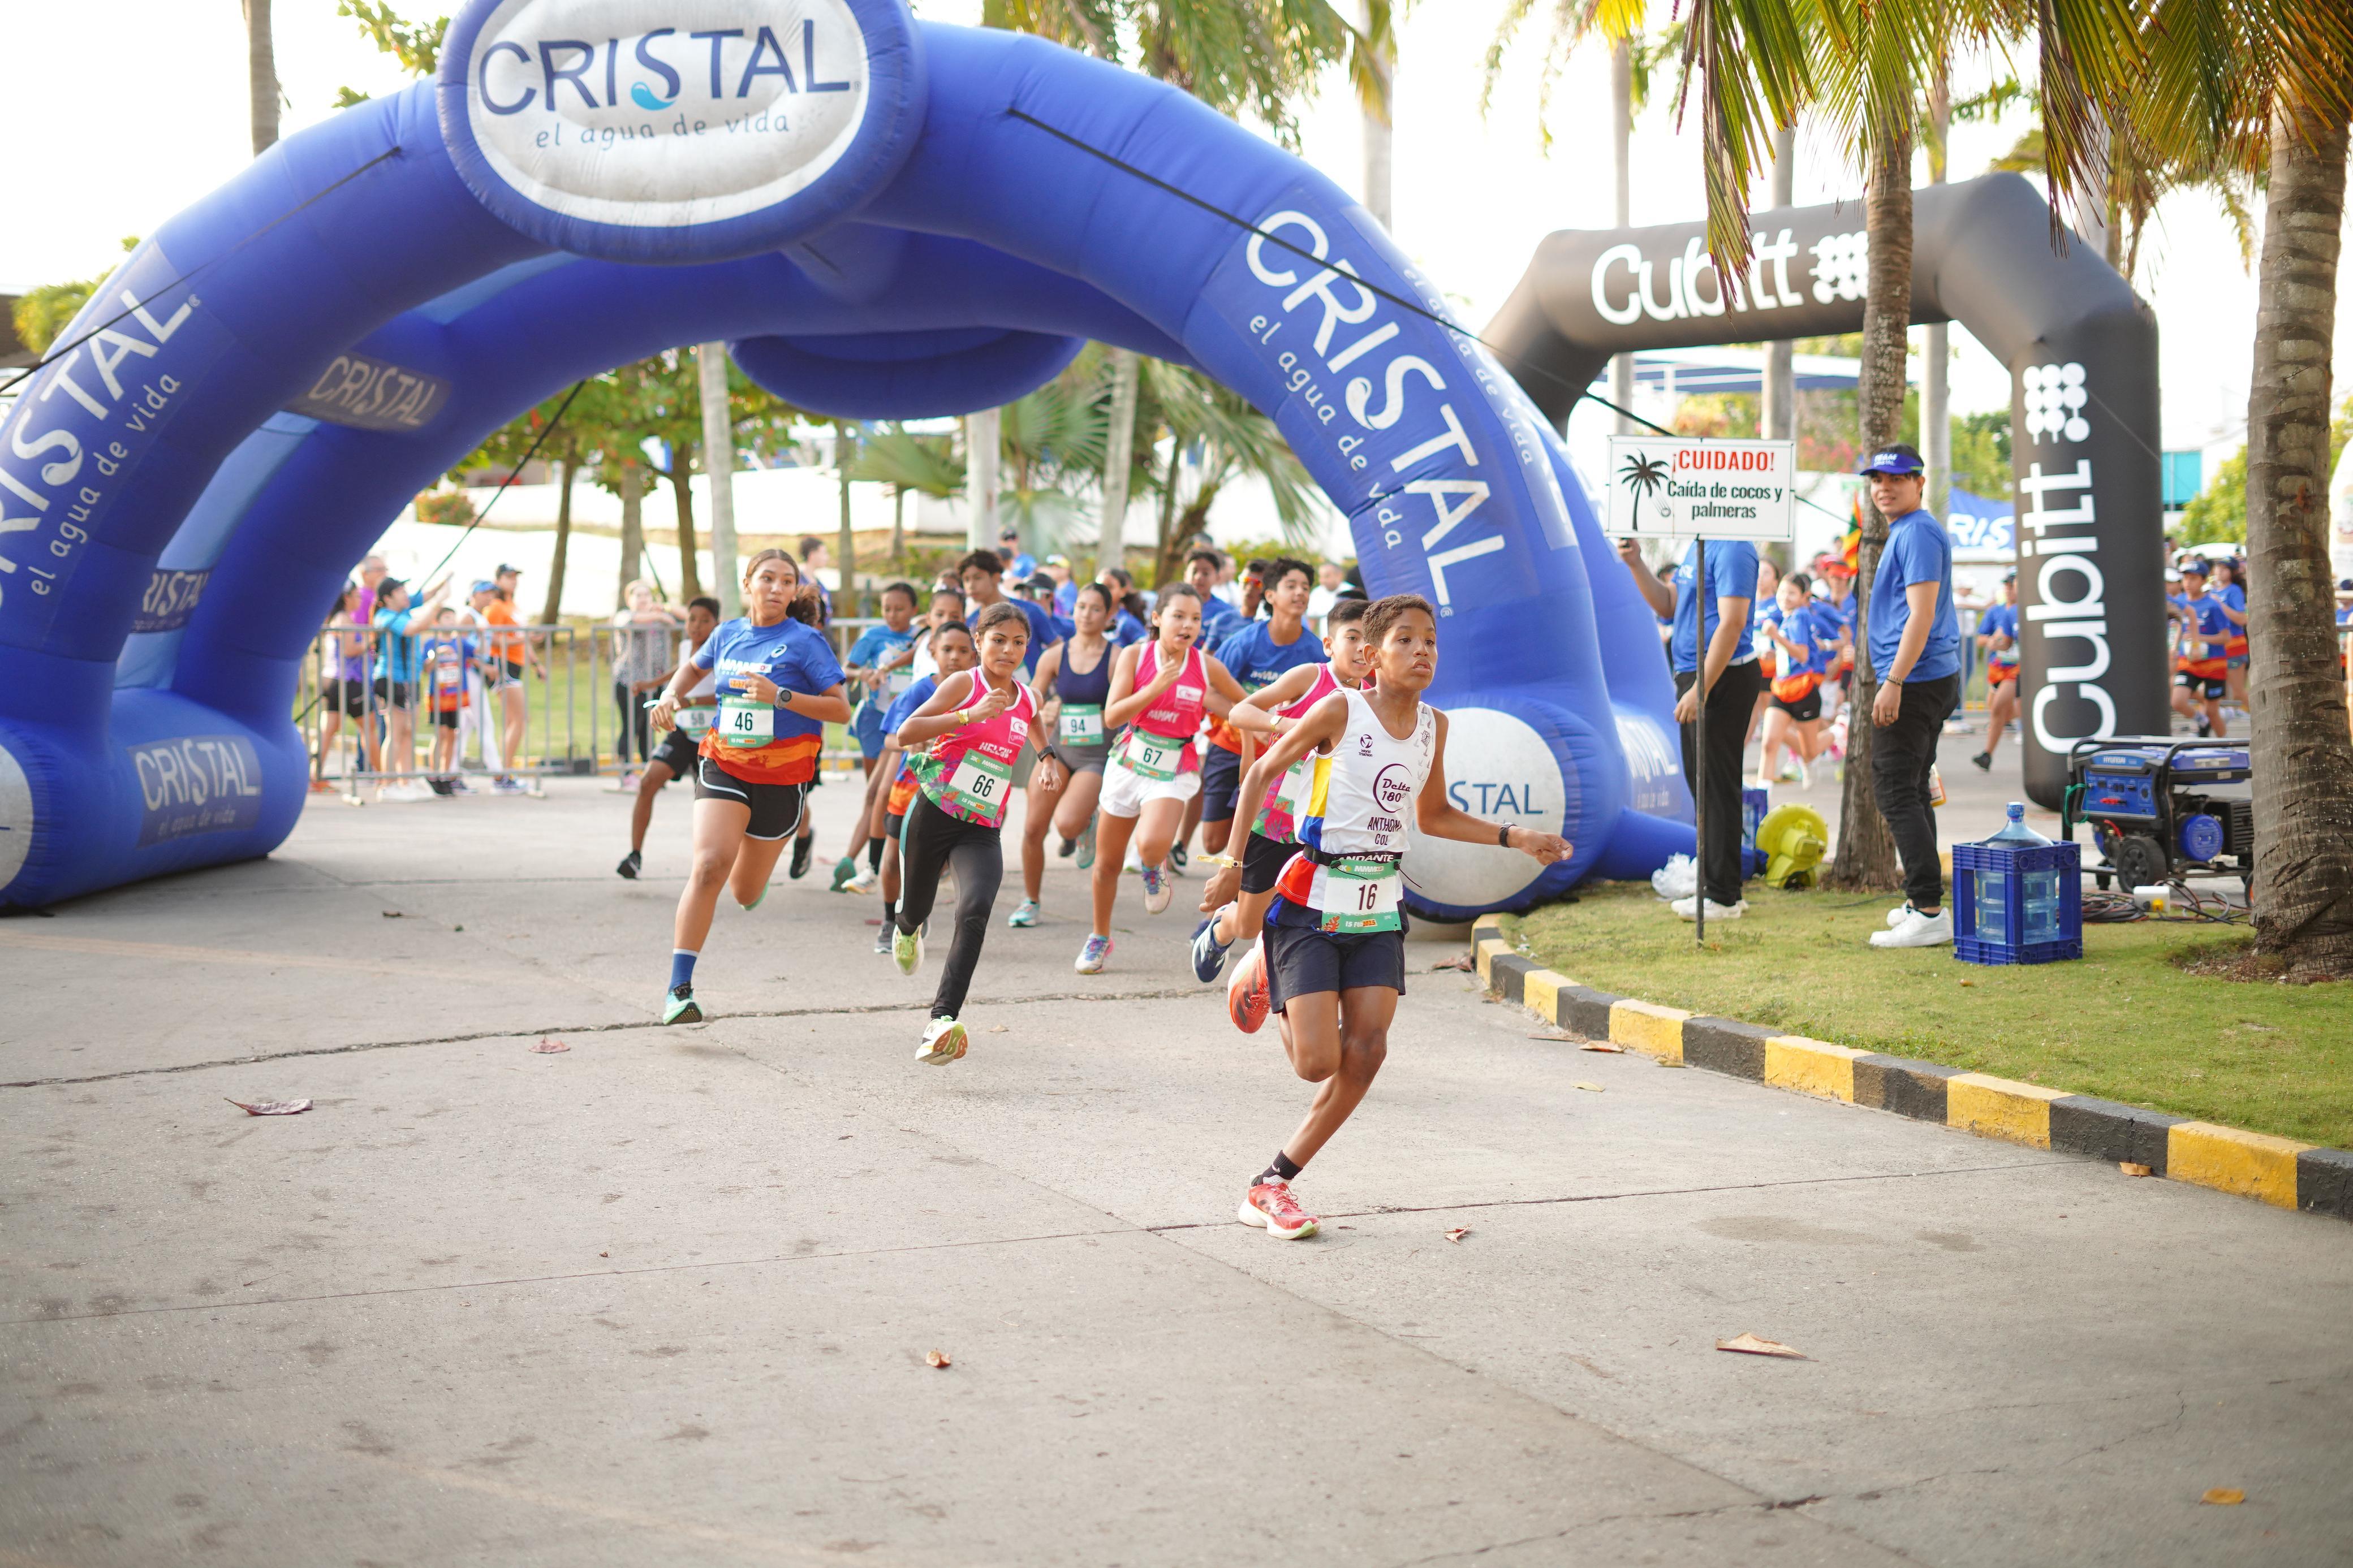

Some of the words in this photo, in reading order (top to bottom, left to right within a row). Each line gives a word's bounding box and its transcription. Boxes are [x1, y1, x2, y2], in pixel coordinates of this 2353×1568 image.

[479, 19, 850, 116] CRISTAL
[536, 123, 561, 148] el
[580, 122, 655, 152] agua
[673, 114, 707, 137] de
[727, 111, 790, 133] vida
[309, 355, 437, 425] CRISTAL
[1246, 210, 1506, 607] CRISTAL
[1475, 368, 1499, 396] de
[1501, 407, 1533, 465] vida
[1249, 314, 1281, 345] el
[1278, 351, 1335, 426] agua
[1338, 434, 1367, 472] de
[1368, 482, 1403, 550] vida
[1672, 450, 1774, 472] ¡CUIDADO!
[28, 566, 55, 596] el
[50, 486, 102, 557] agua
[93, 441, 128, 476] de
[126, 374, 182, 431] vida
[1667, 480, 1706, 498] Caída
[1710, 482, 1727, 499] de
[1731, 487, 1771, 499] cocos
[1774, 487, 1783, 502] y
[1691, 501, 1756, 520] palmeras
[2020, 459, 2118, 754] Cubitt
[735, 712, 753, 731] 46
[1071, 719, 1085, 733] 94
[1143, 748, 1163, 766] 67
[136, 738, 261, 811] CRISTAL
[972, 775, 995, 797] 66
[1382, 778, 1410, 792] Delta
[1374, 833, 1388, 845] COL
[1359, 884, 1378, 910] 16
